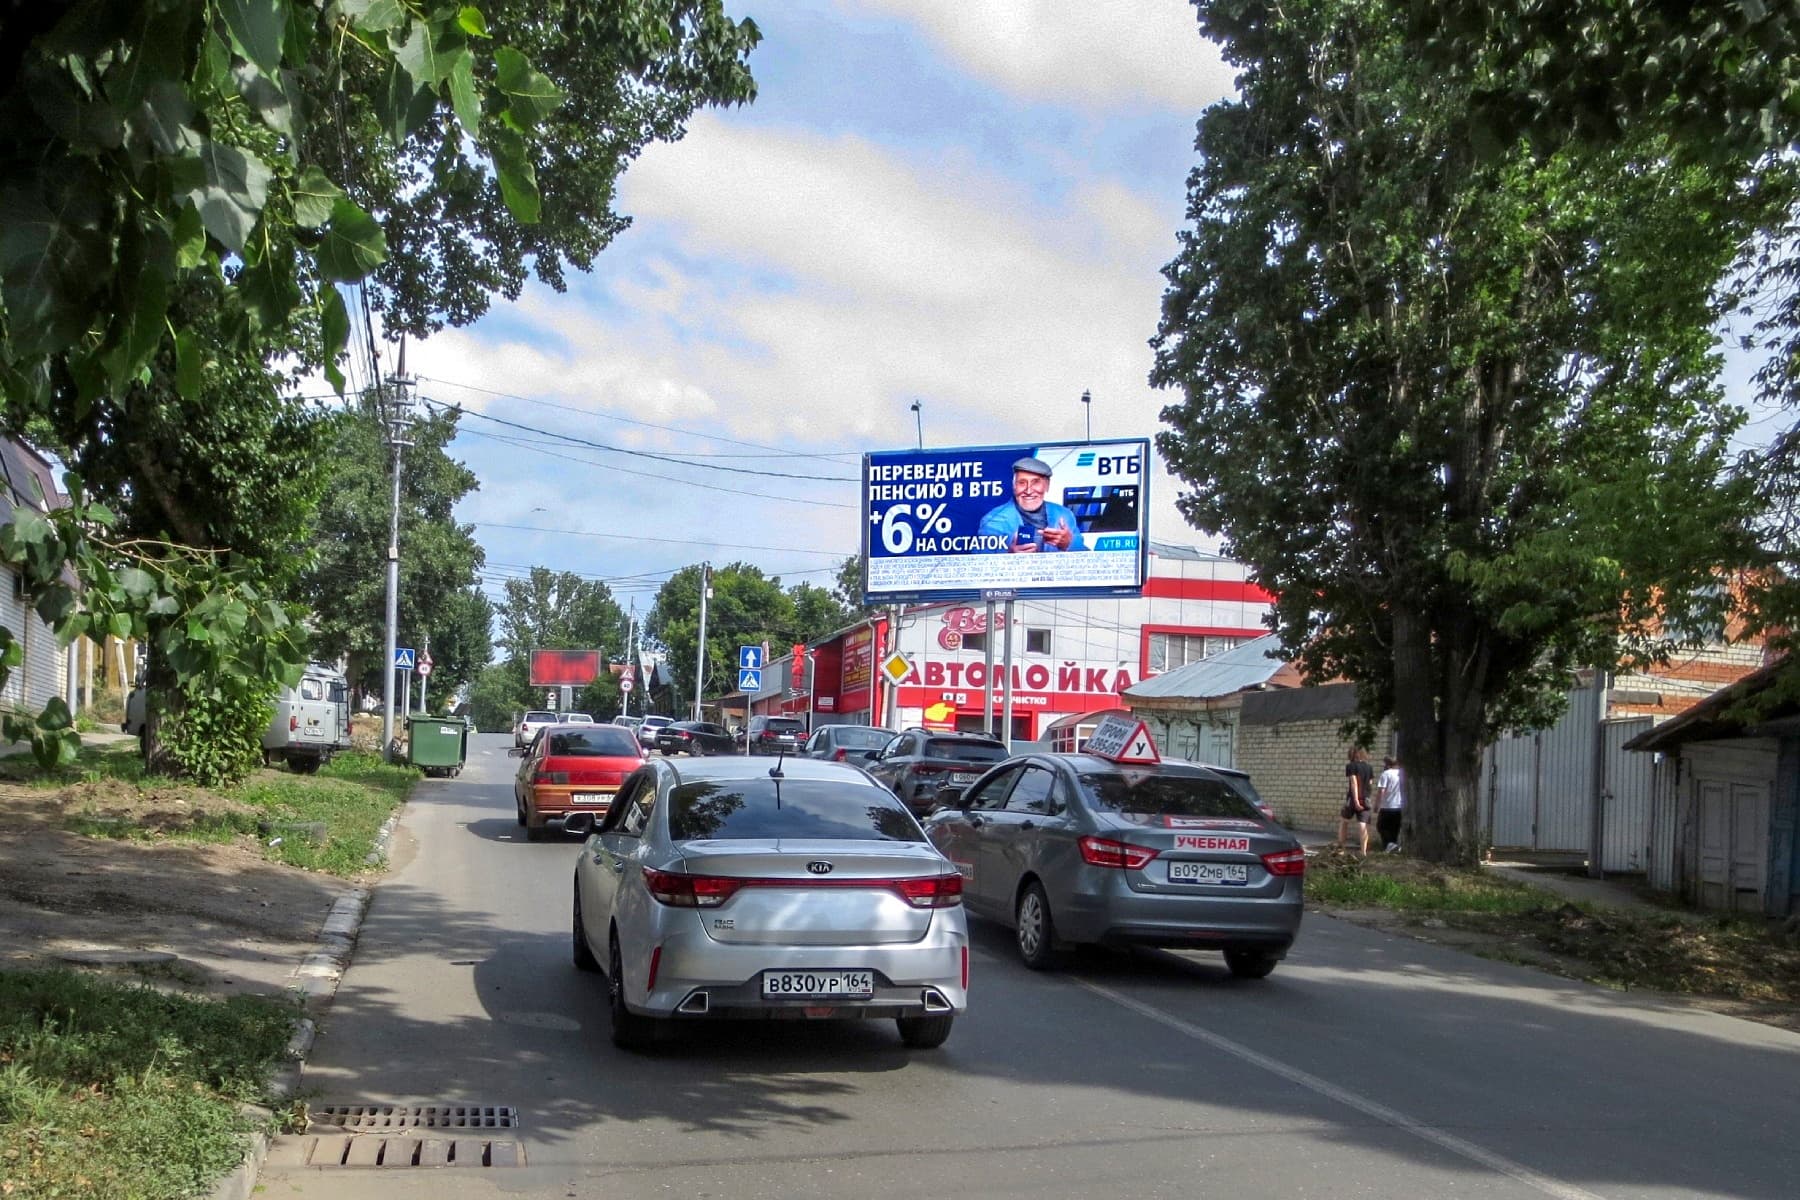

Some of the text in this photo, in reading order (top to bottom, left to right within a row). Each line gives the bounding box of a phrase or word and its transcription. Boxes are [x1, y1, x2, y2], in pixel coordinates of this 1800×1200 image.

[869, 462, 983, 482] ПЕРЕВЕДИТЕ
[1098, 455, 1140, 475] ВТБ
[869, 480, 1003, 500] ПЕНСИЮ В ВТБ
[916, 538, 937, 552] НА
[941, 535, 1008, 550] ОСТАТОК
[1102, 538, 1137, 549] VTB.RU
[938, 607, 1018, 651] Bes
[901, 660, 1133, 693] АВТОМОЙКА
[1177, 837, 1248, 850] УЧЕБНАЯ
[810, 863, 830, 872] KIA
[1174, 864, 1245, 879] В092МВ 164
[769, 973, 869, 993] В830УР 164
